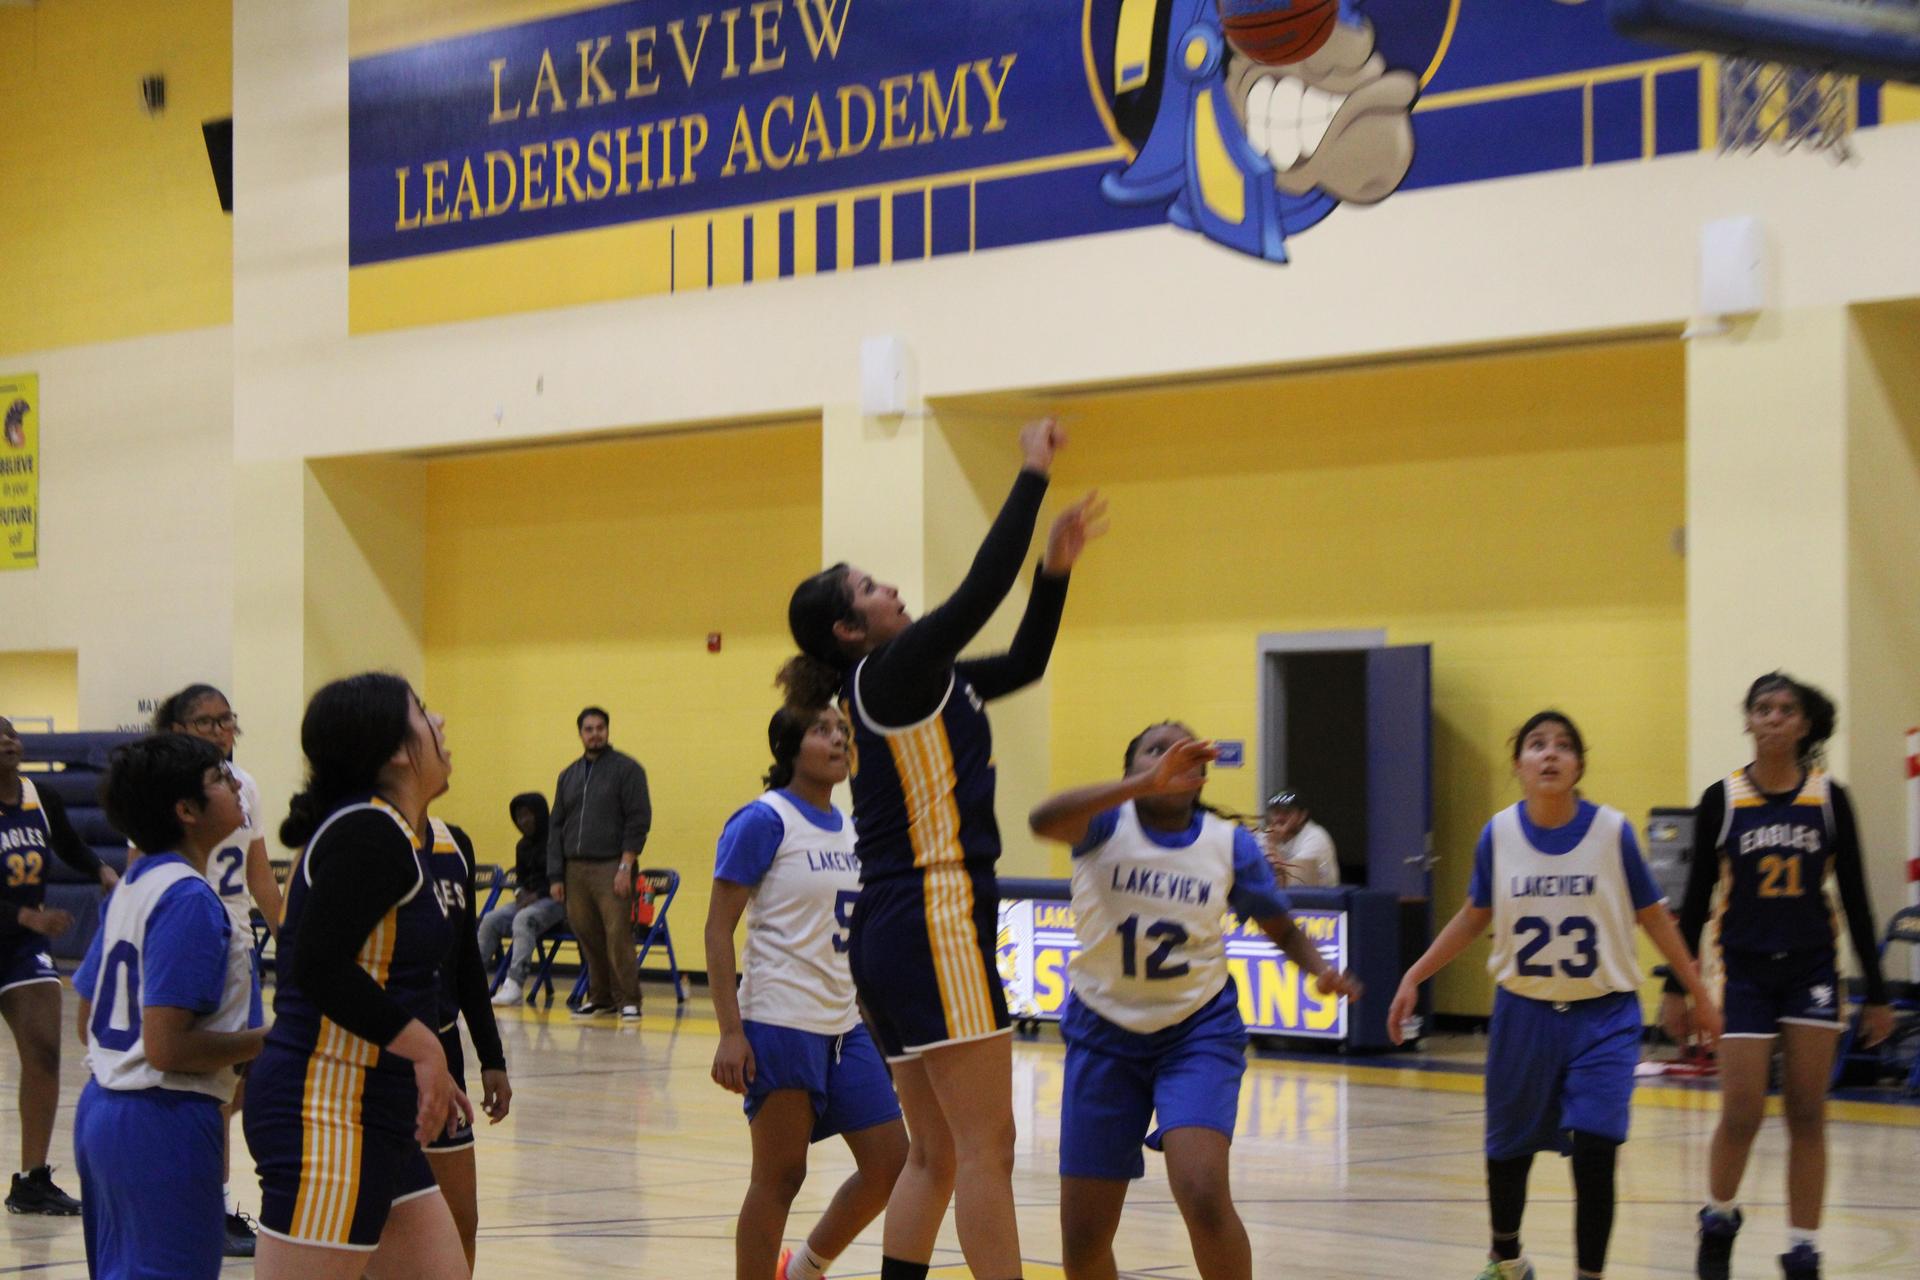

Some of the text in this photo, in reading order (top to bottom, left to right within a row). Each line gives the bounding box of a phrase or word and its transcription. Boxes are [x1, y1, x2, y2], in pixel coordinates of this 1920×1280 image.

[489, 0, 851, 124] LAKEVIEW
[395, 53, 1018, 231] LEADERSHIP ACADEMY
[1740, 823, 1821, 855] EAGLES
[7, 850, 43, 887] 32
[216, 846, 244, 896] 2
[1111, 863, 1212, 907] LAKEVIEW
[1511, 873, 1598, 898] LAKEVIEW
[1758, 853, 1805, 897] 21
[1116, 913, 1191, 980] 12
[1513, 915, 1599, 978] 23
[91, 939, 142, 1052] 0
